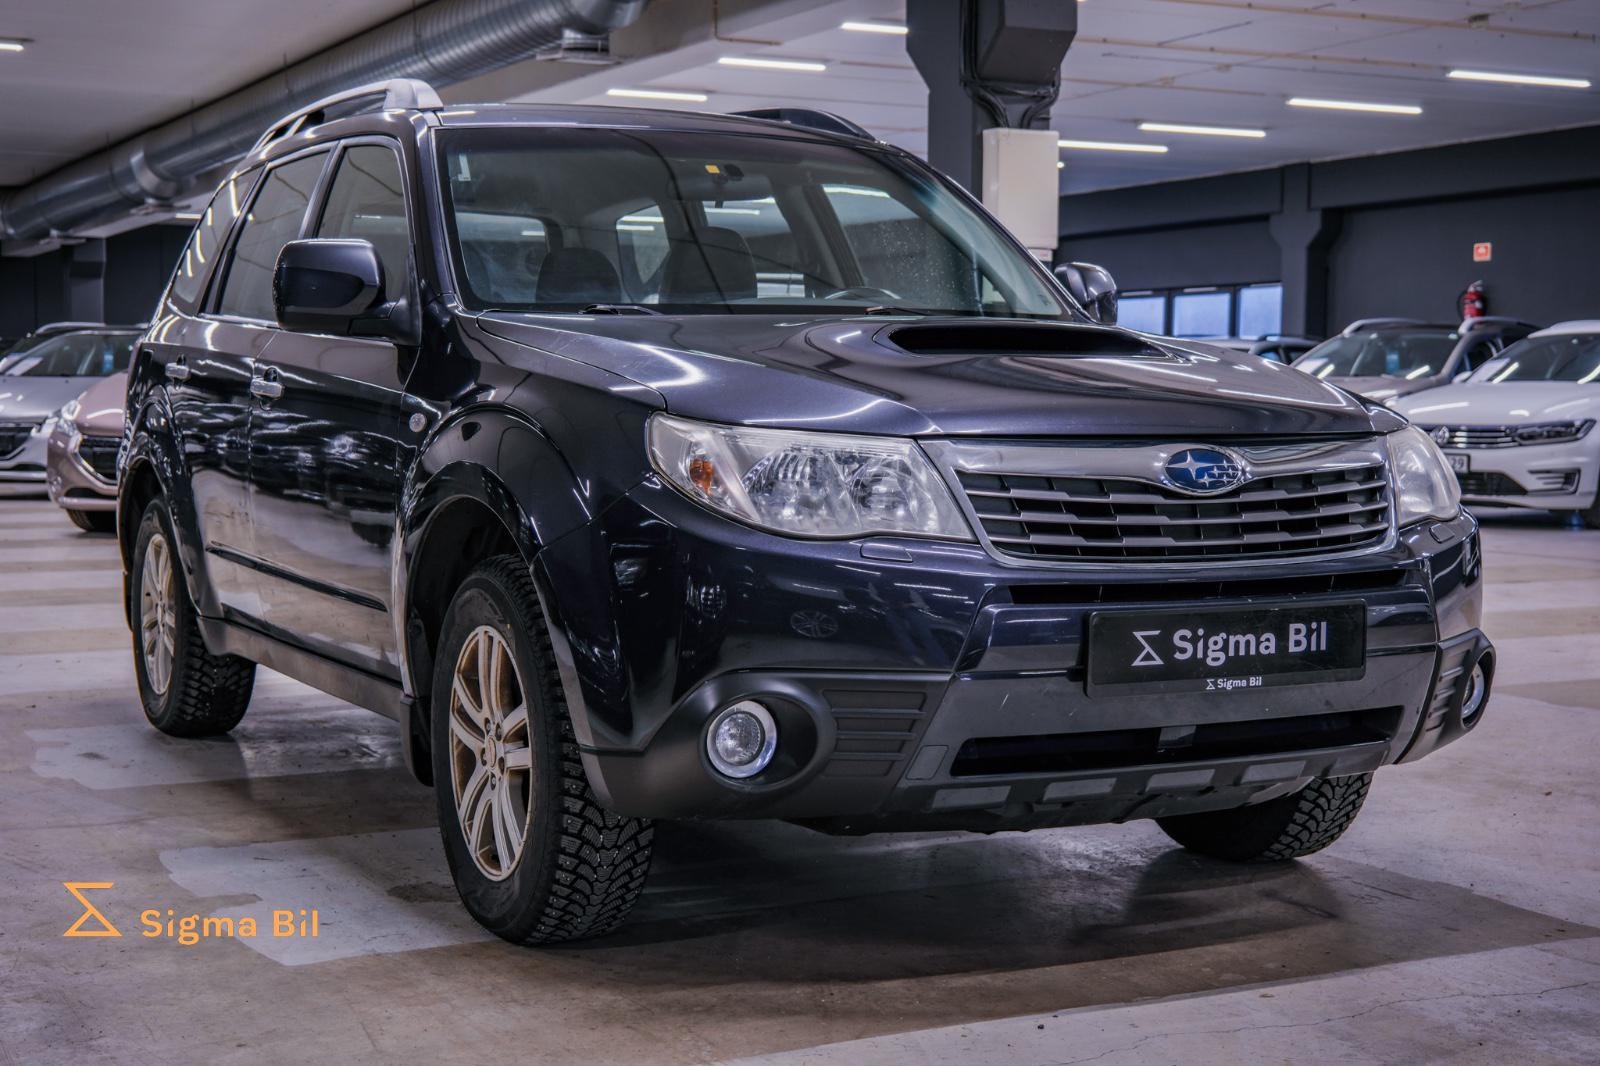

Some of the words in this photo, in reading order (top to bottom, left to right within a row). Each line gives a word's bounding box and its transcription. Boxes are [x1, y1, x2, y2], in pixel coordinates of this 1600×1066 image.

[1173, 628, 1276, 667] Sigma
[1288, 621, 1327, 653] Bil
[1217, 678, 1247, 691] Sigma
[1249, 676, 1262, 687] Bil
